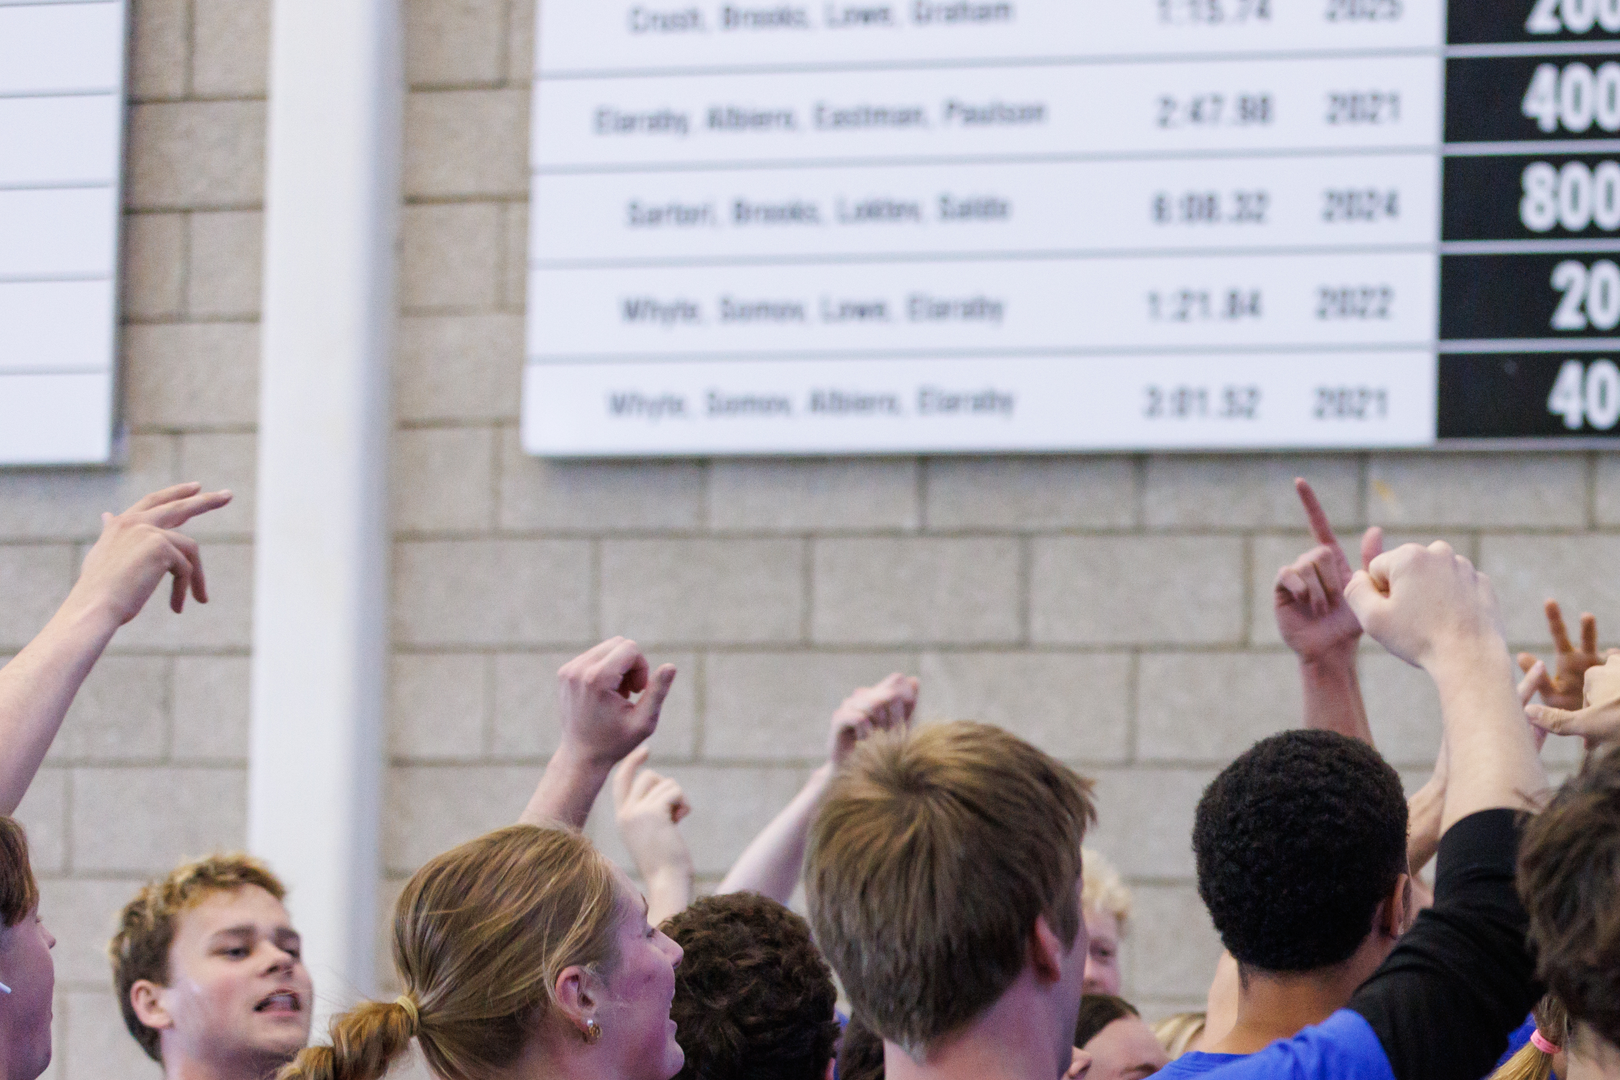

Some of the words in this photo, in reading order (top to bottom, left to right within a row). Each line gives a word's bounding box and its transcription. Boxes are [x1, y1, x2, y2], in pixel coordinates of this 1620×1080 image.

[1325, 90, 1401, 126] 2021
[1322, 188, 1400, 223] 2024
[1315, 285, 1395, 321] 2022
[1312, 386, 1388, 421] 2021
